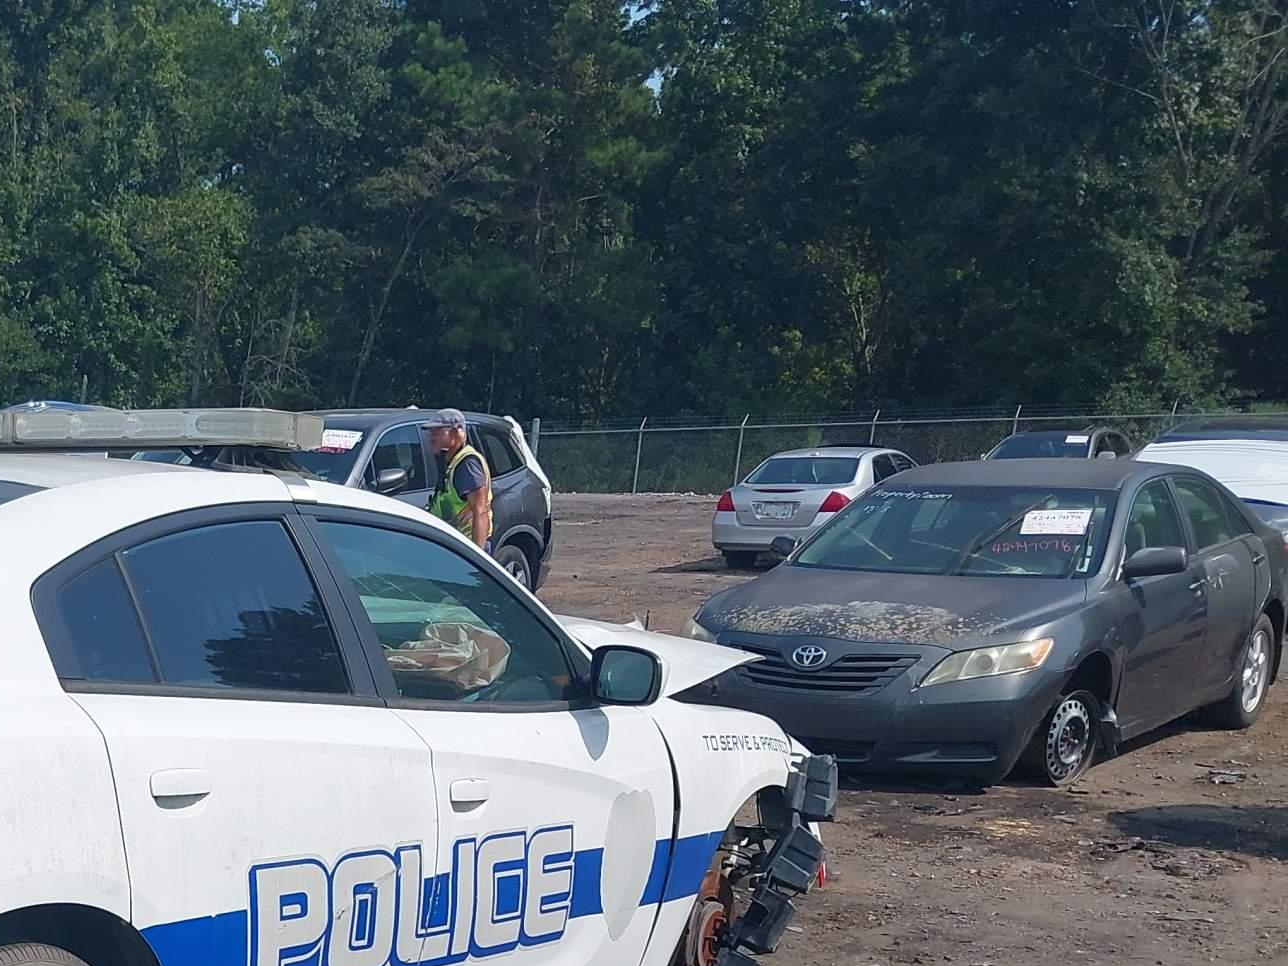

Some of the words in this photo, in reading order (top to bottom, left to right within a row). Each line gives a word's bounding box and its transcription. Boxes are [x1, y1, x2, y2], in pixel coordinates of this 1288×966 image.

[702, 735, 718, 751] TO
[719, 735, 752, 751] SERVE
[752, 735, 761, 751] &
